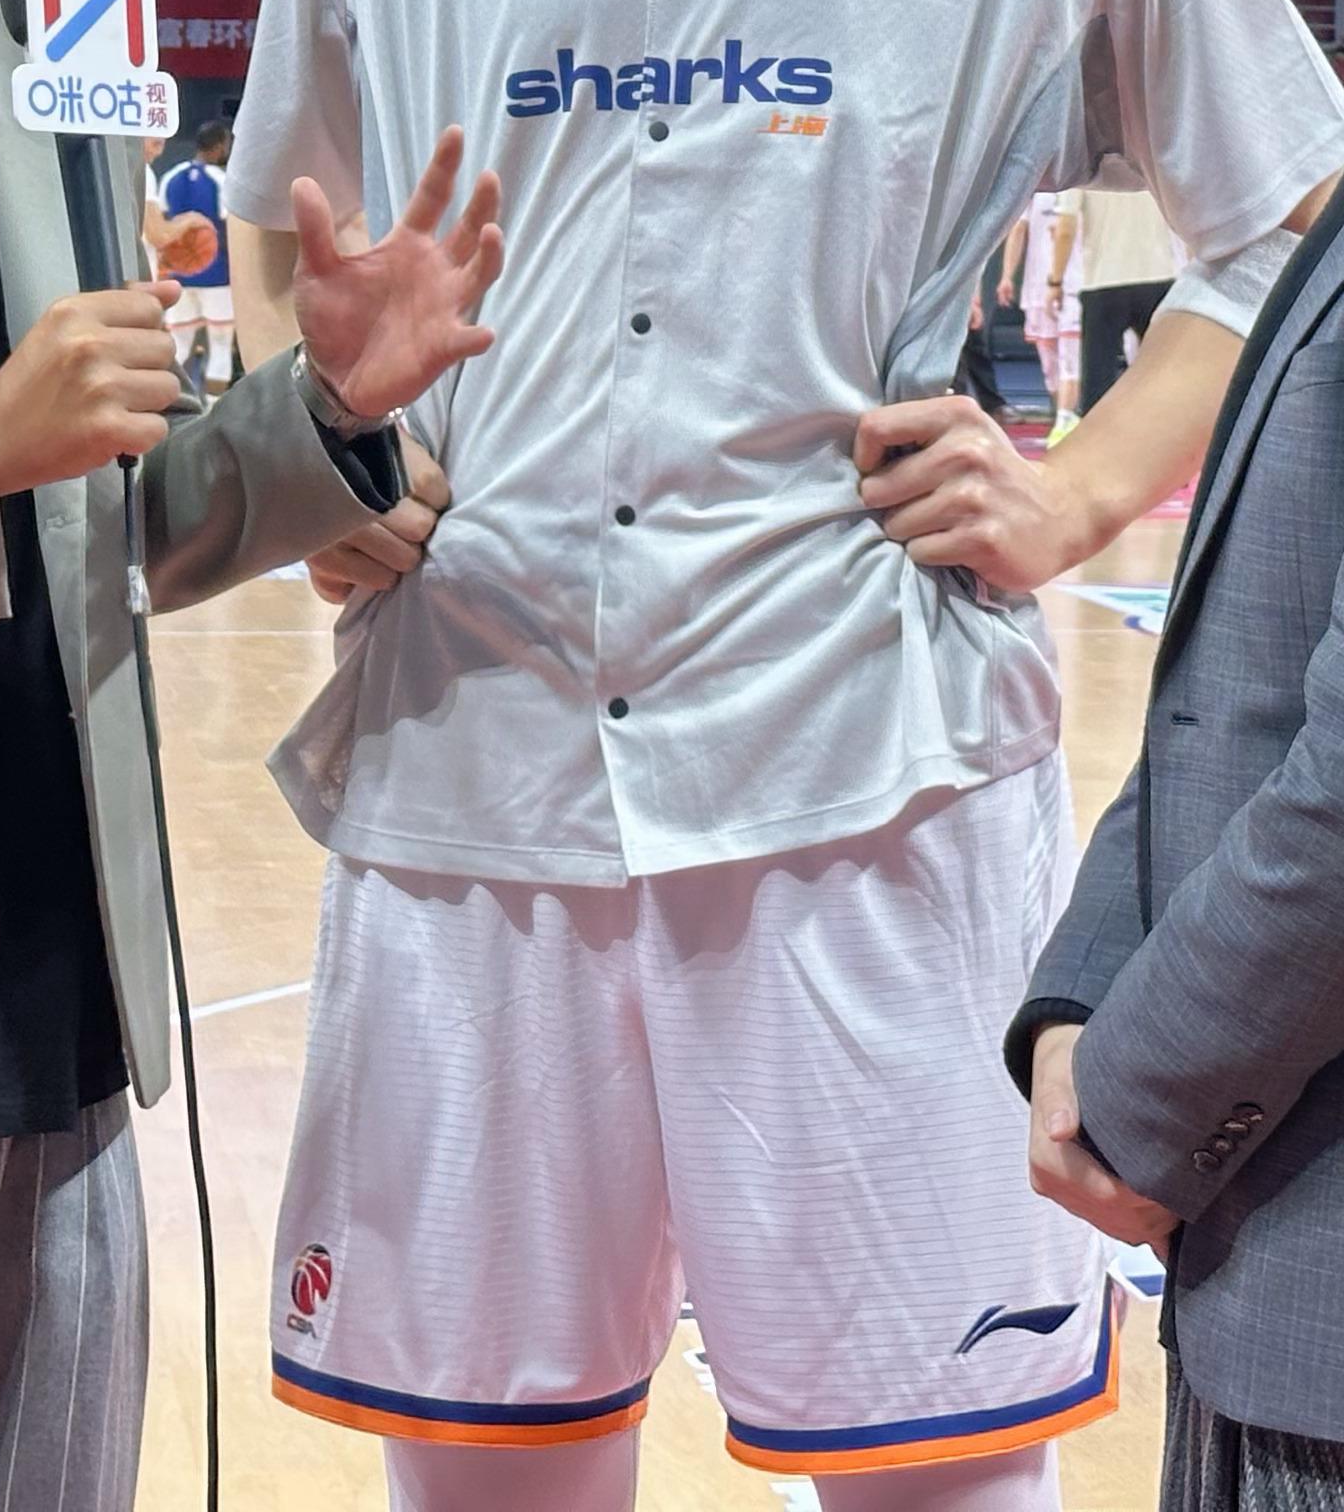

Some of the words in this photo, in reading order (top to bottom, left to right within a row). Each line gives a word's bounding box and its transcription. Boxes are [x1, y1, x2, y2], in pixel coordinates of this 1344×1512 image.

[27, 75, 142, 128] 咪咕
[505, 38, 833, 118] sharks
[145, 82, 168, 129] 视频
